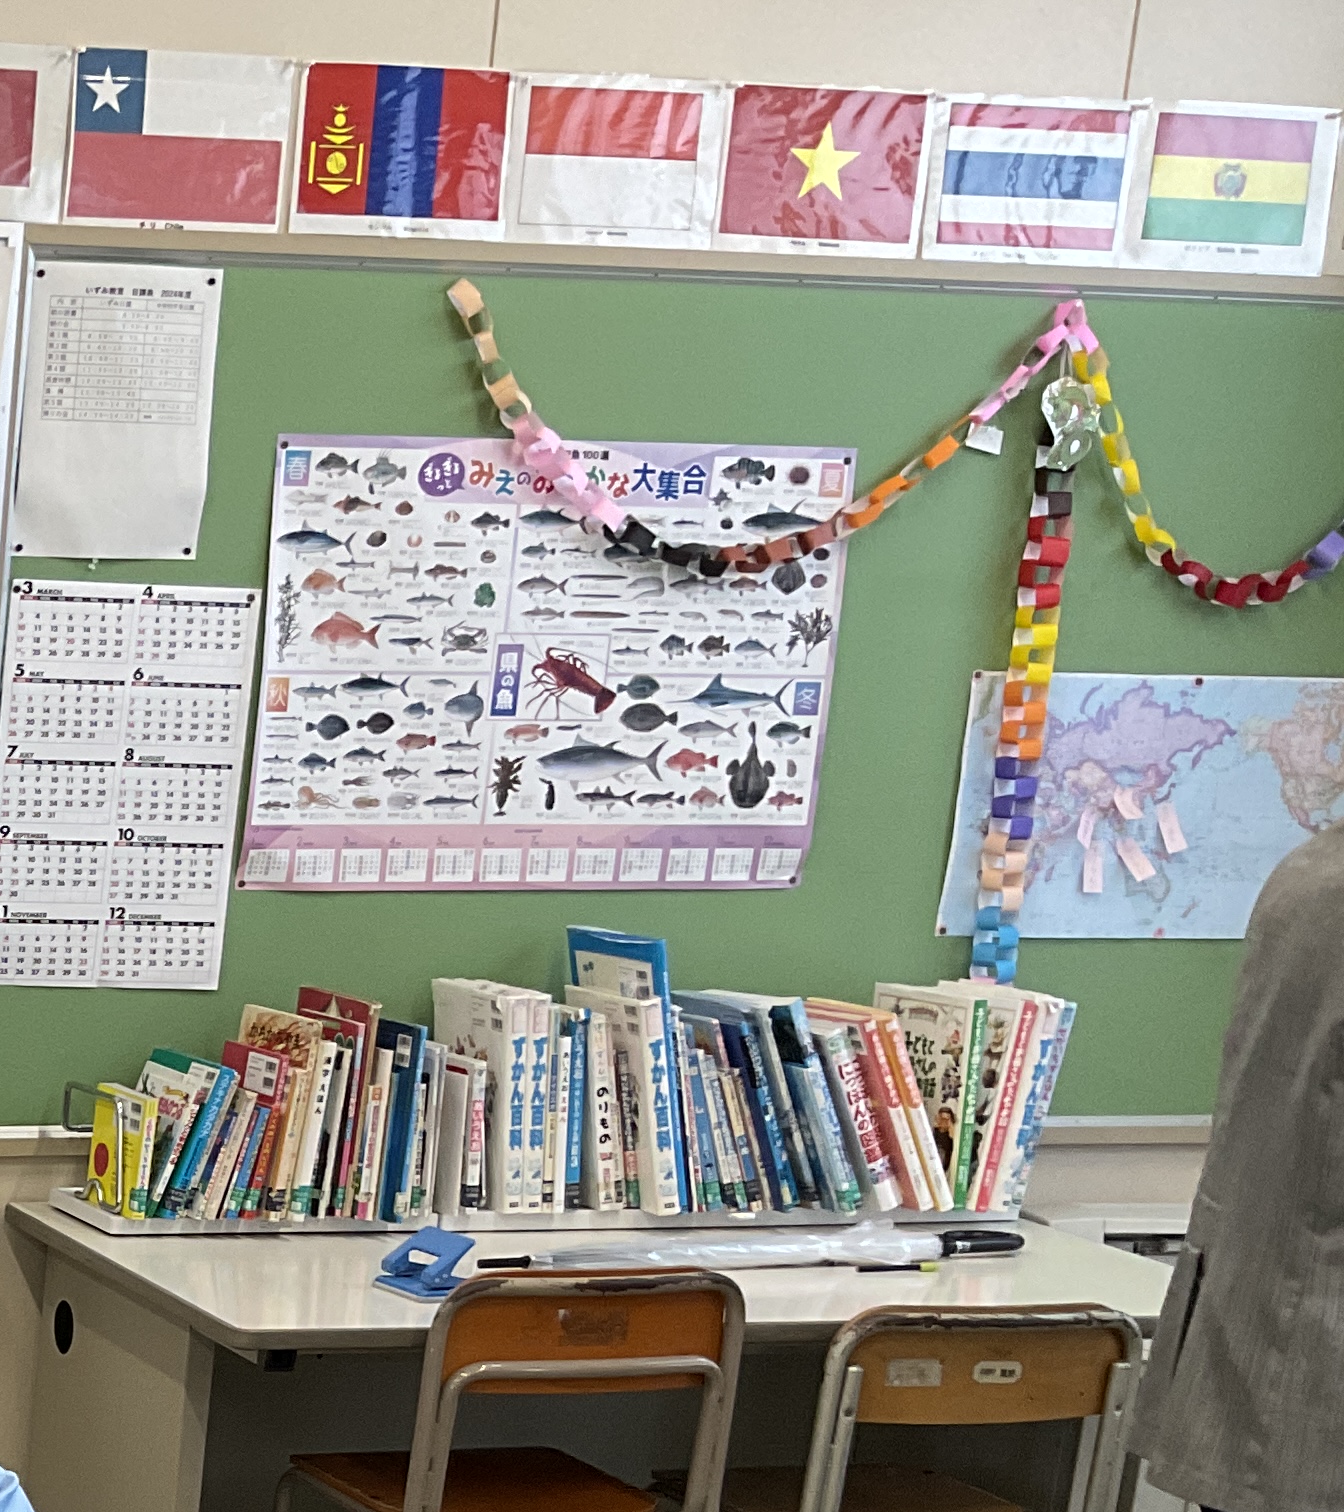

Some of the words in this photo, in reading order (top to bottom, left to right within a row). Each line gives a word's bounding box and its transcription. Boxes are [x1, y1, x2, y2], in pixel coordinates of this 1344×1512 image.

[286, 455, 309, 482] 春
[22, 581, 34, 595] 3
[142, 586, 154, 599] 4
[14, 664, 26, 678] 5
[132, 667, 145, 681] 6
[497, 652, 521, 713] 県の魚
[269, 683, 290, 709] 秋
[797, 685, 820, 712] 冬
[7, 745, 17, 759] 7
[124, 748, 134, 762] 8
[0, 825, 11, 839] 9
[118, 828, 135, 841] 10
[109, 907, 126, 920] 12
[596, 1087, 612, 1144] のりもの
